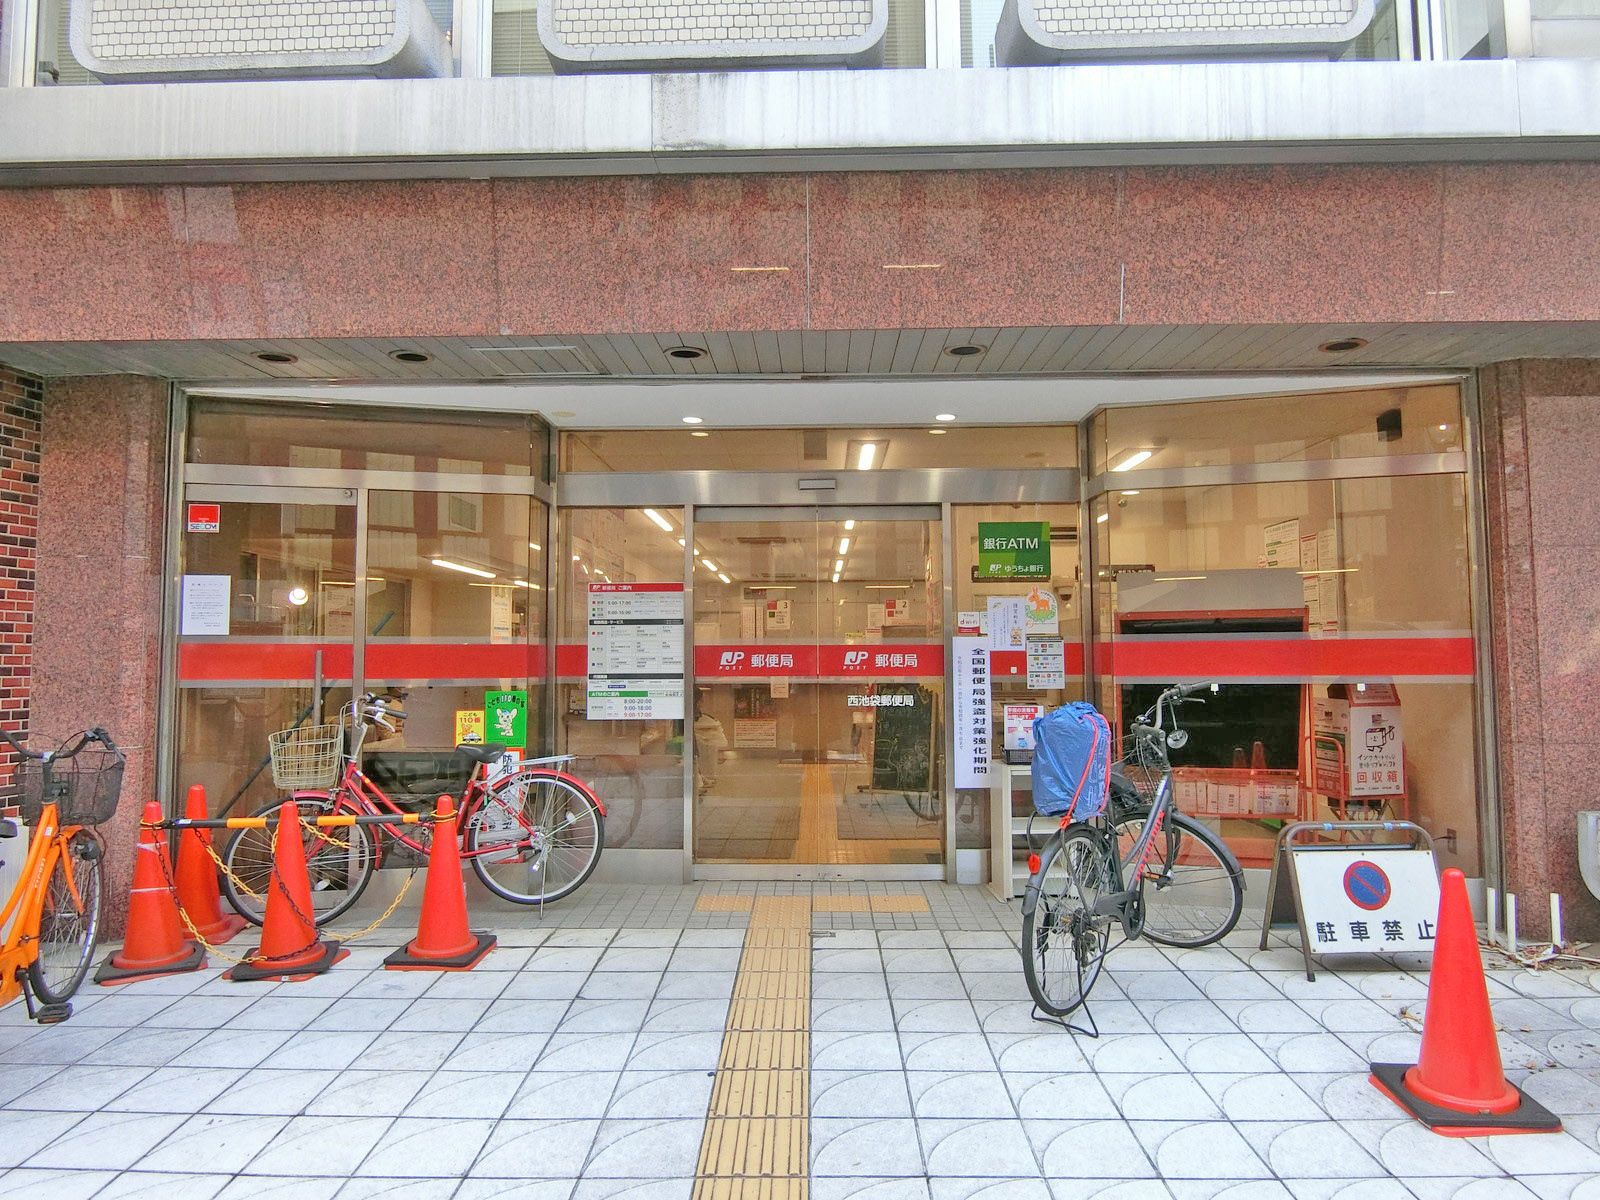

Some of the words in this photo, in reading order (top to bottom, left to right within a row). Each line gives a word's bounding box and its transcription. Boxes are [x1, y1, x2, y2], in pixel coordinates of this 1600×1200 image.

[983, 537, 1039, 550] 銀行ATM
[1004, 564, 1044, 573] ゆうちょ銀行
[783, 601, 789, 609] 3
[902, 600, 908, 609] 2
[751, 653, 794, 668] 郵便局
[875, 653, 918, 668] 郵便局
[847, 695, 915, 707] 西池袋郵便局
[971, 647, 987, 774] 全国郵便局強盗対策強化期間
[1356, 770, 1399, 784] 回収箱
[1315, 919, 1436, 943] 駐車禁止
